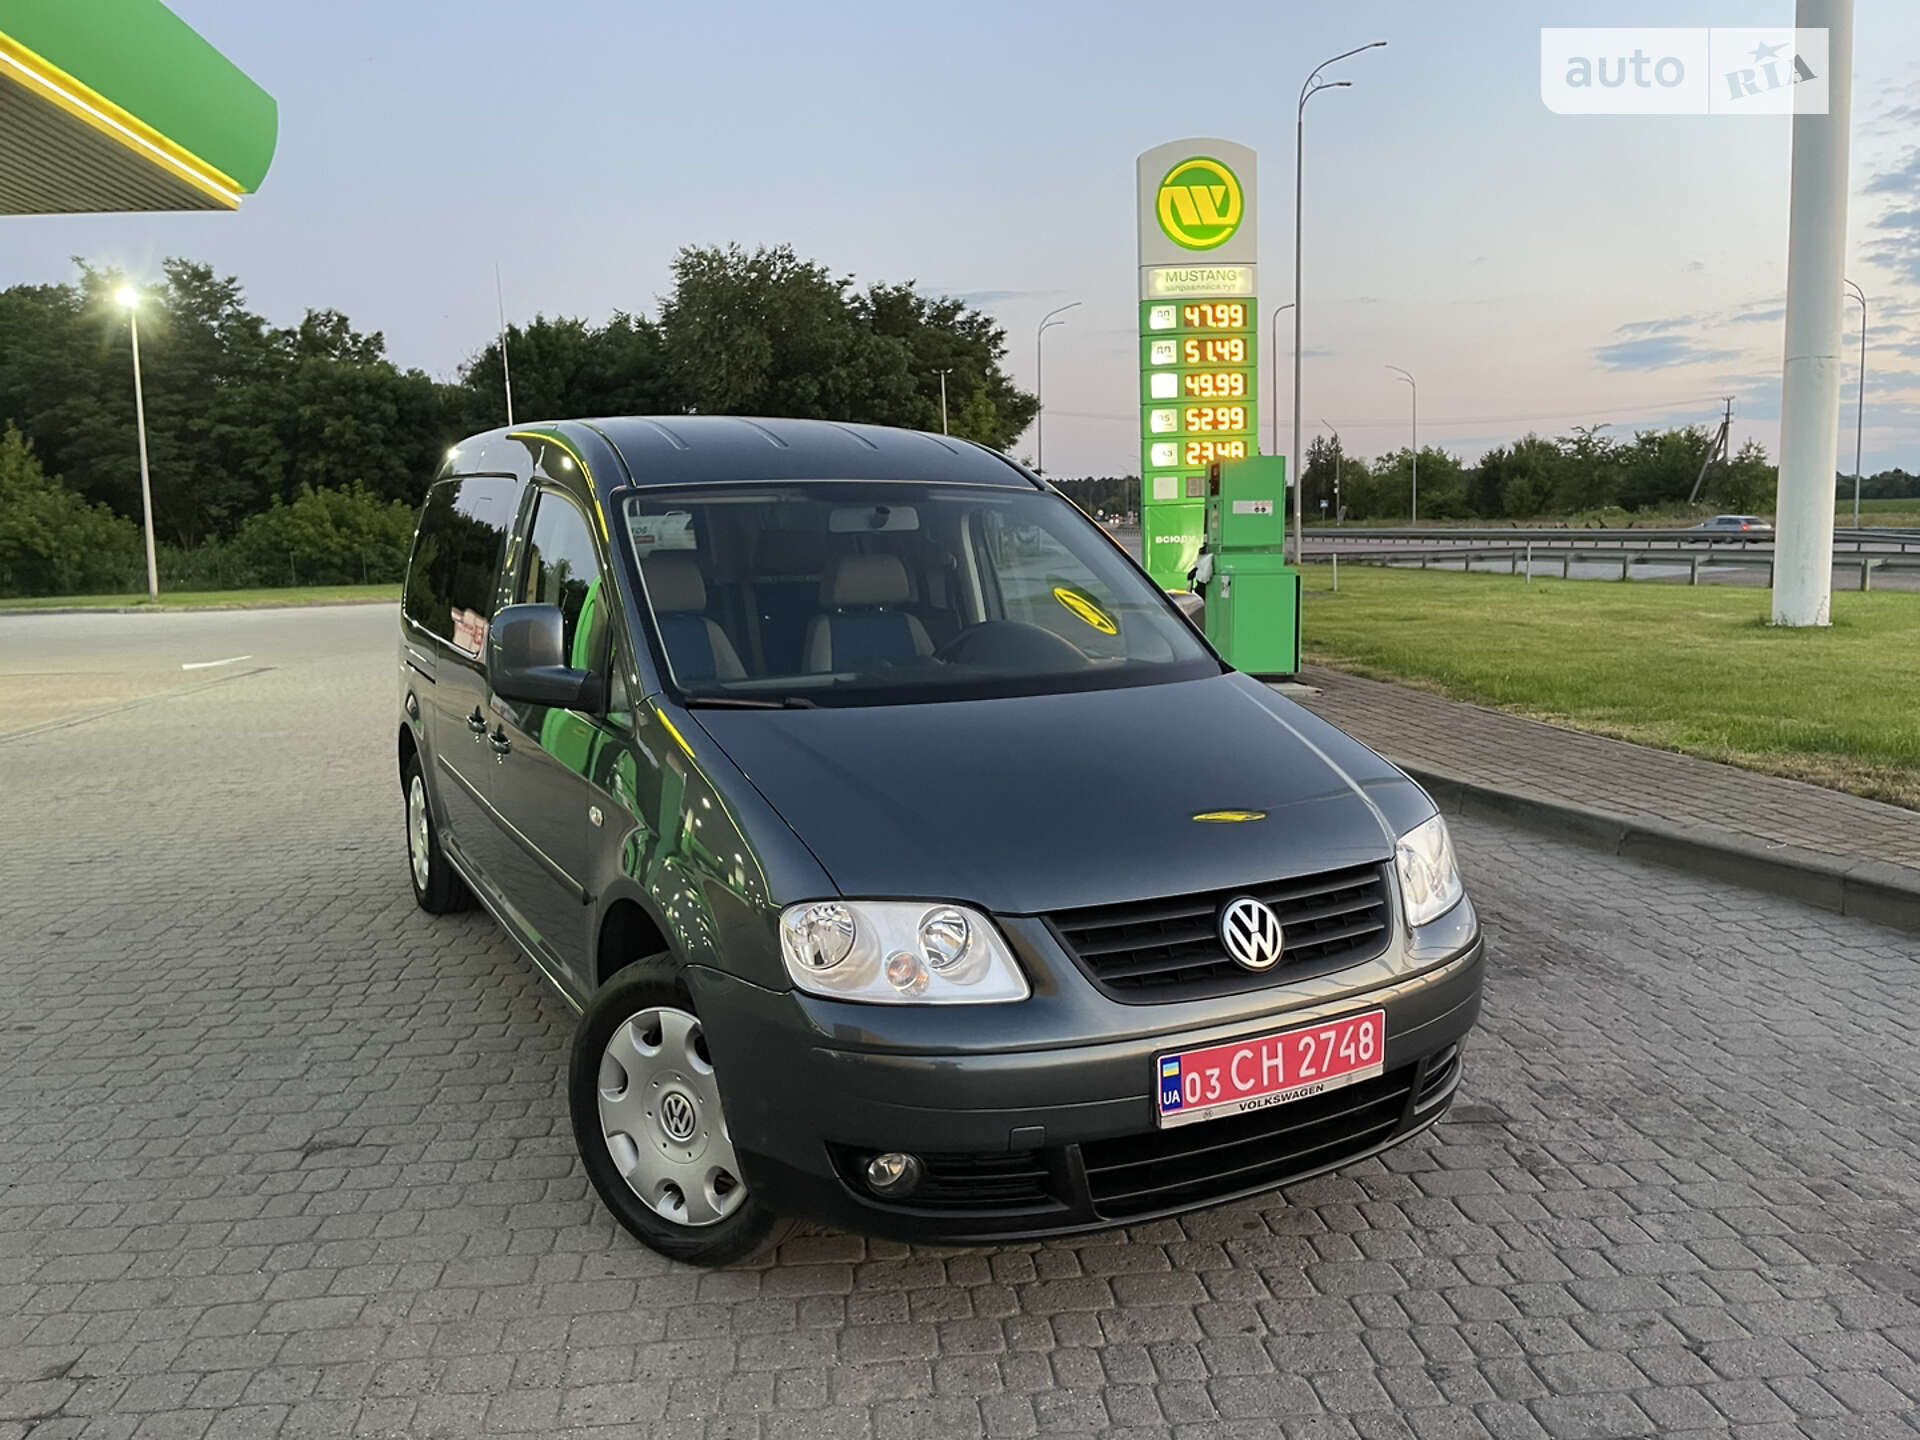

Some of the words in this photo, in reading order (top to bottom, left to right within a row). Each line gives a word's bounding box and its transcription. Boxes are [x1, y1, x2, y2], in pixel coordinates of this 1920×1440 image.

[1165, 269, 1237, 283] MUSTANG
[1184, 304, 1244, 328] 47.99
[1185, 338, 1244, 364] 51.49
[1185, 373, 1244, 397] 49.99
[1185, 1067, 1221, 1105] 03
[1230, 1041, 1286, 1092] CH
[1298, 1020, 1375, 1078] 2748
[1163, 1089, 1181, 1105] UA
[1239, 1083, 1324, 1111] VOLKSWAGEN
